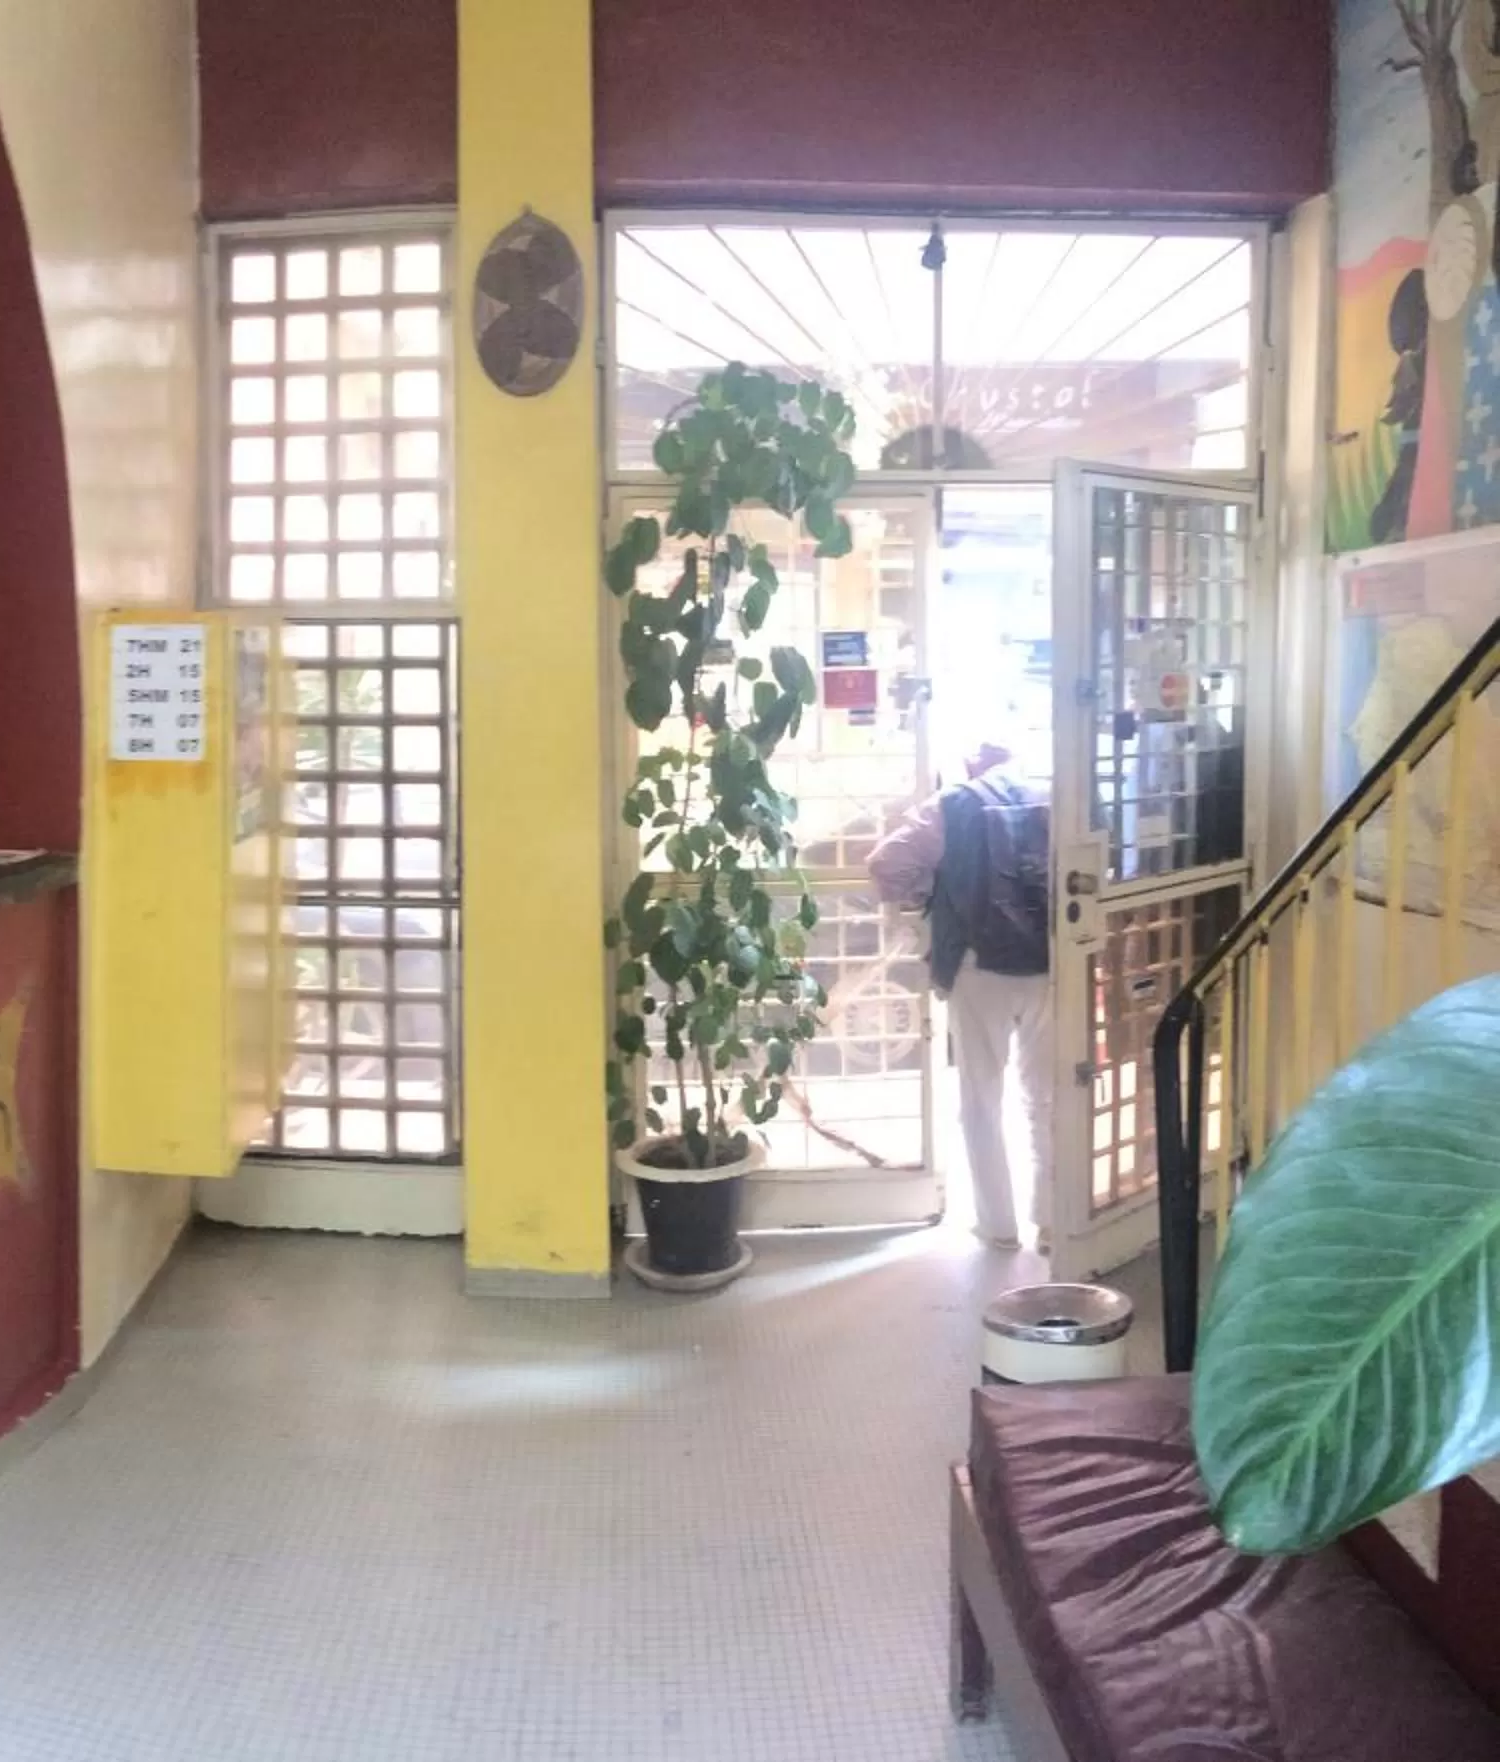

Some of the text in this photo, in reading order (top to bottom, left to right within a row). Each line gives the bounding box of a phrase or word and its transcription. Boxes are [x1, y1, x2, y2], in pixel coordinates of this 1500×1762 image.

[180, 639, 200, 653] 21
[126, 664, 151, 678] 2H
[127, 713, 153, 728] 7H
